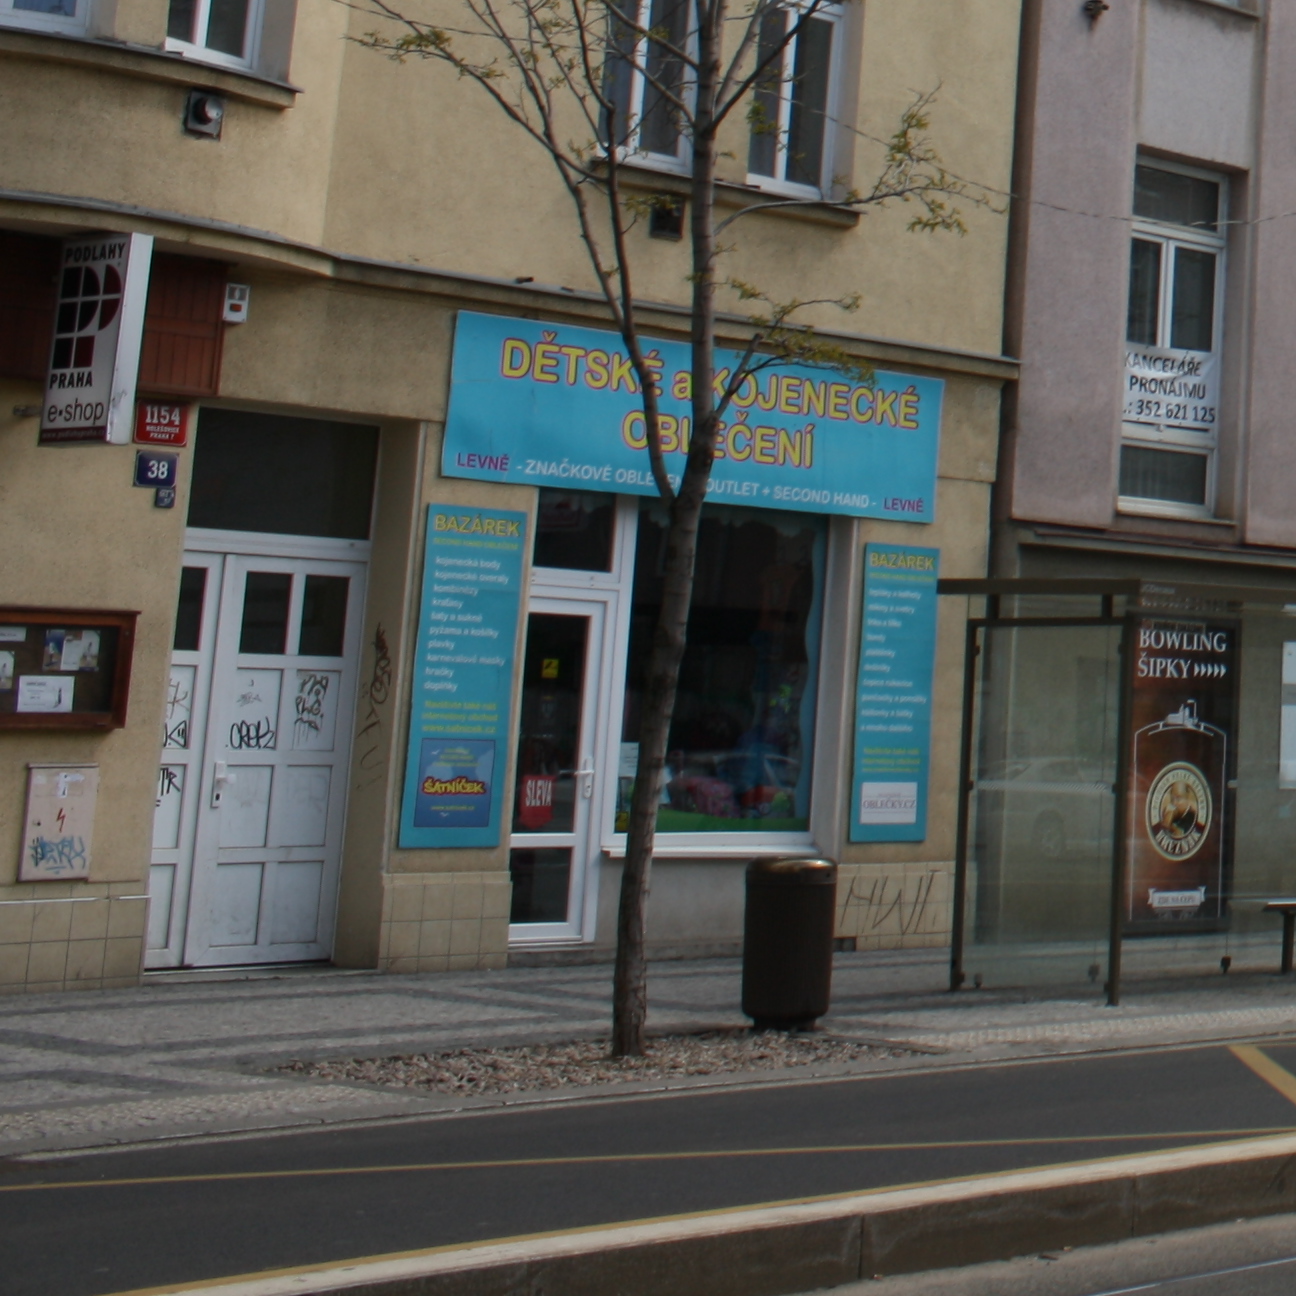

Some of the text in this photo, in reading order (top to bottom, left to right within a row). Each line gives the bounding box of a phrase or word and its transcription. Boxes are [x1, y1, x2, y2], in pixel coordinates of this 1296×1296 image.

[65, 242, 126, 263] PODLAHY
[502, 331, 664, 396] DĚTSKÉ
[672, 370, 692, 399] a
[49, 371, 93, 390] PRAHA
[1129, 375, 1206, 400] PRONÁJMU
[146, 406, 180, 426] 1154
[1136, 399, 1161, 419] 352
[1165, 404, 1188, 421] 621
[1193, 406, 1215, 423] 125
[149, 432, 169, 440] PRAHA
[148, 460, 168, 479] 38
[457, 452, 510, 471] LEVNÉ
[525, 458, 611, 482] ZNAČKOVÉ
[615, 469, 683, 489] OBLEEN
[705, 478, 759, 496] OUTLET
[773, 486, 830, 504] SECOND
[833, 492, 869, 508] HAND
[884, 497, 923, 513] LEVNÉ
[434, 513, 520, 537] BAZÁREK
[869, 552, 935, 571] BAZÁREK
[1139, 628, 1227, 652] BOWLING
[1137, 651, 1192, 678] ŠIPKY
[422, 777, 486, 795] ŠATNÍČEK
[525, 779, 552, 806] SLEVA
